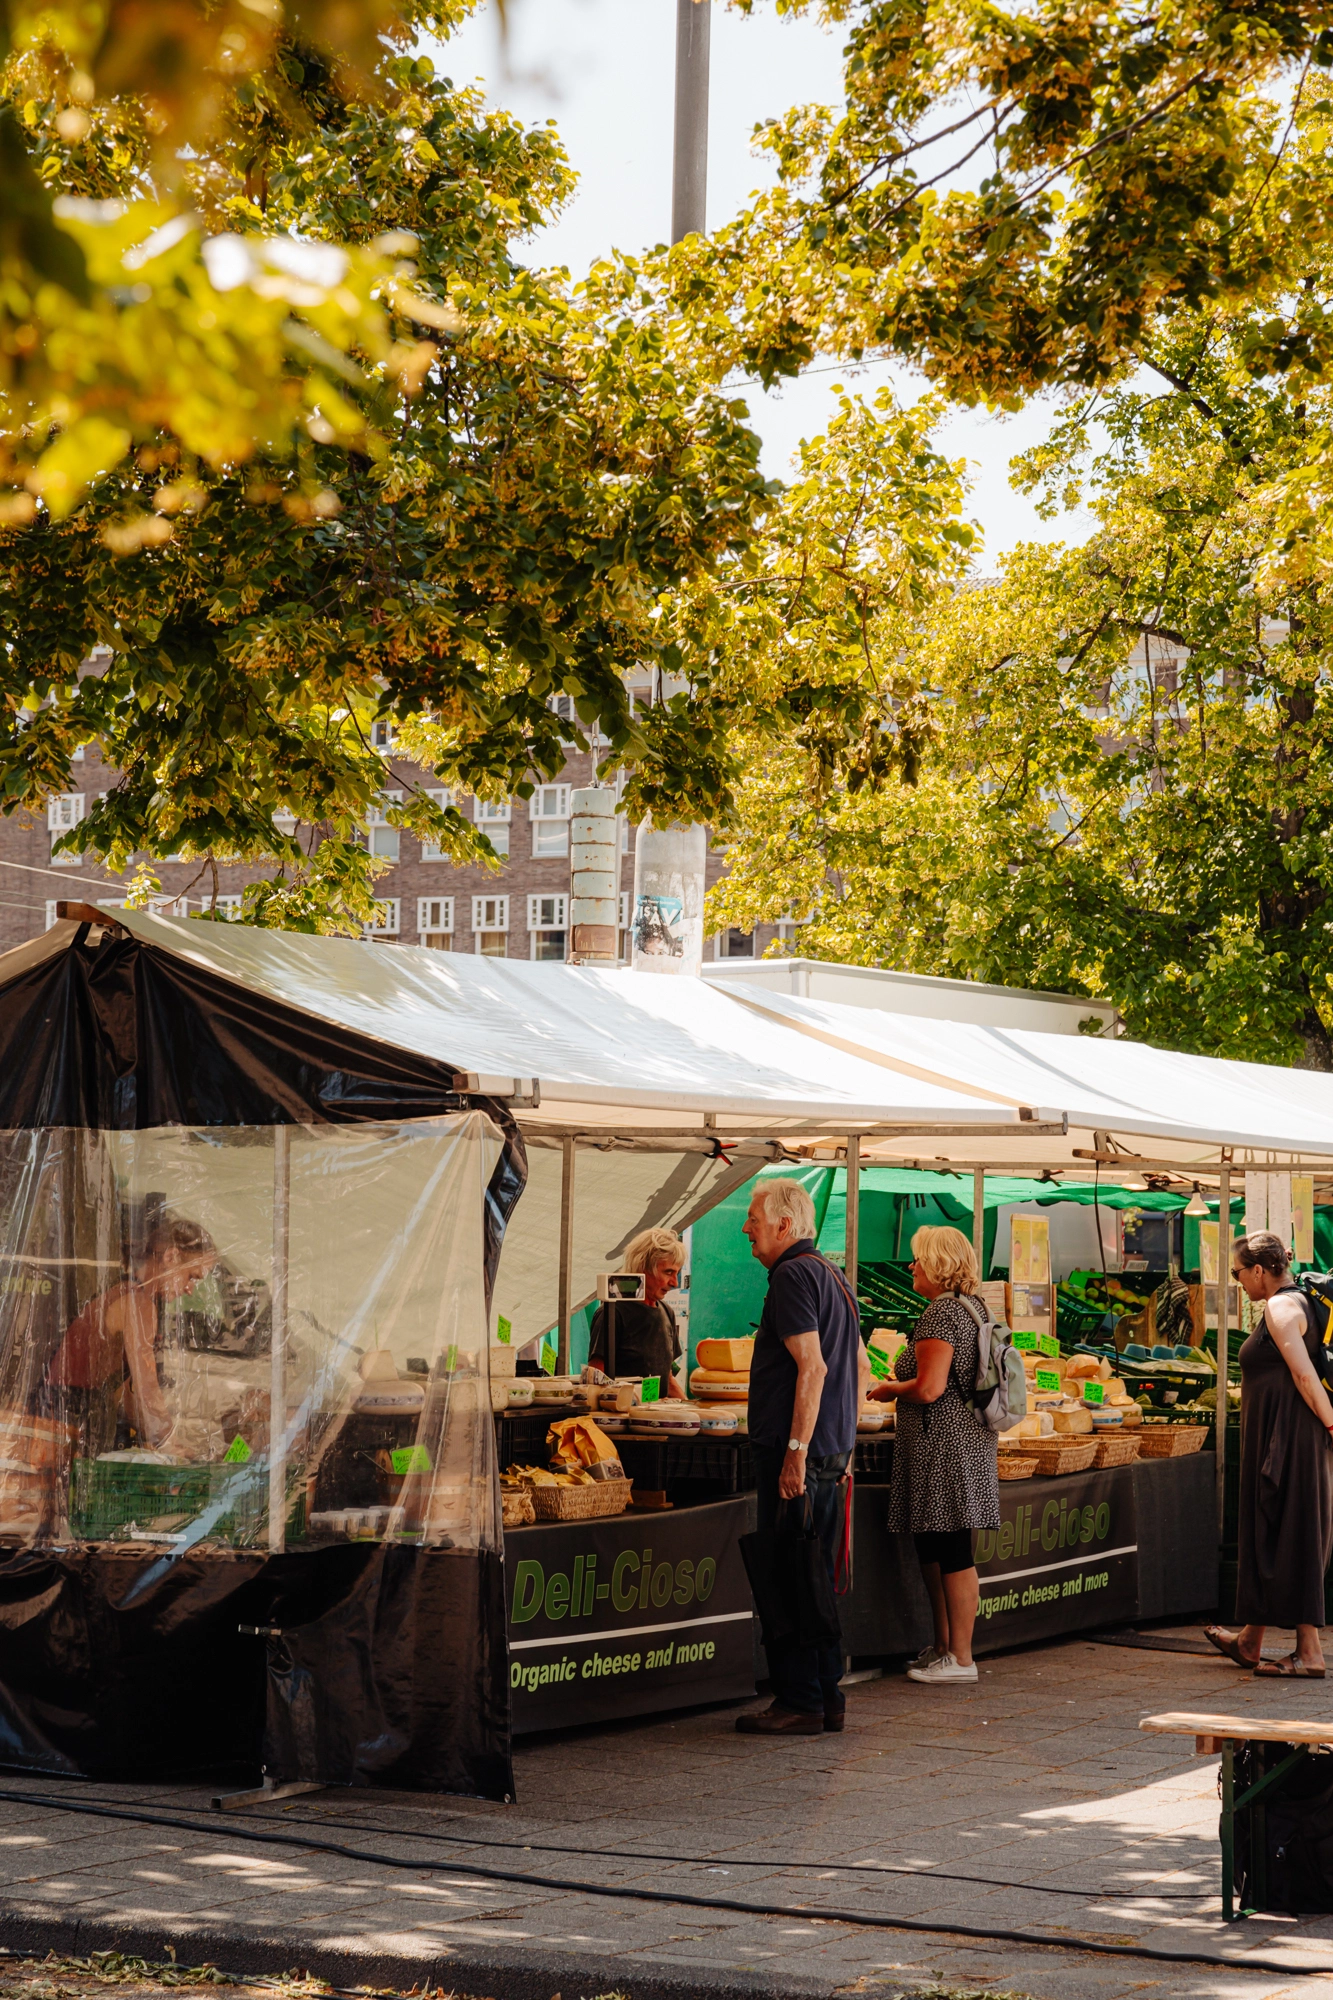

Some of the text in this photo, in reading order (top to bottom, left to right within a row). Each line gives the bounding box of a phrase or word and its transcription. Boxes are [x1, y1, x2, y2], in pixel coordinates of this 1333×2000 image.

[974, 1497, 1111, 1564] Deli-Cioso
[511, 1548, 717, 1624] Deli-Cioso
[1021, 1583, 1060, 1607] cheese
[1062, 1573, 1082, 1597] and
[1084, 1571, 1109, 1592] more
[510, 1640, 715, 1693] Organic cheese and more
